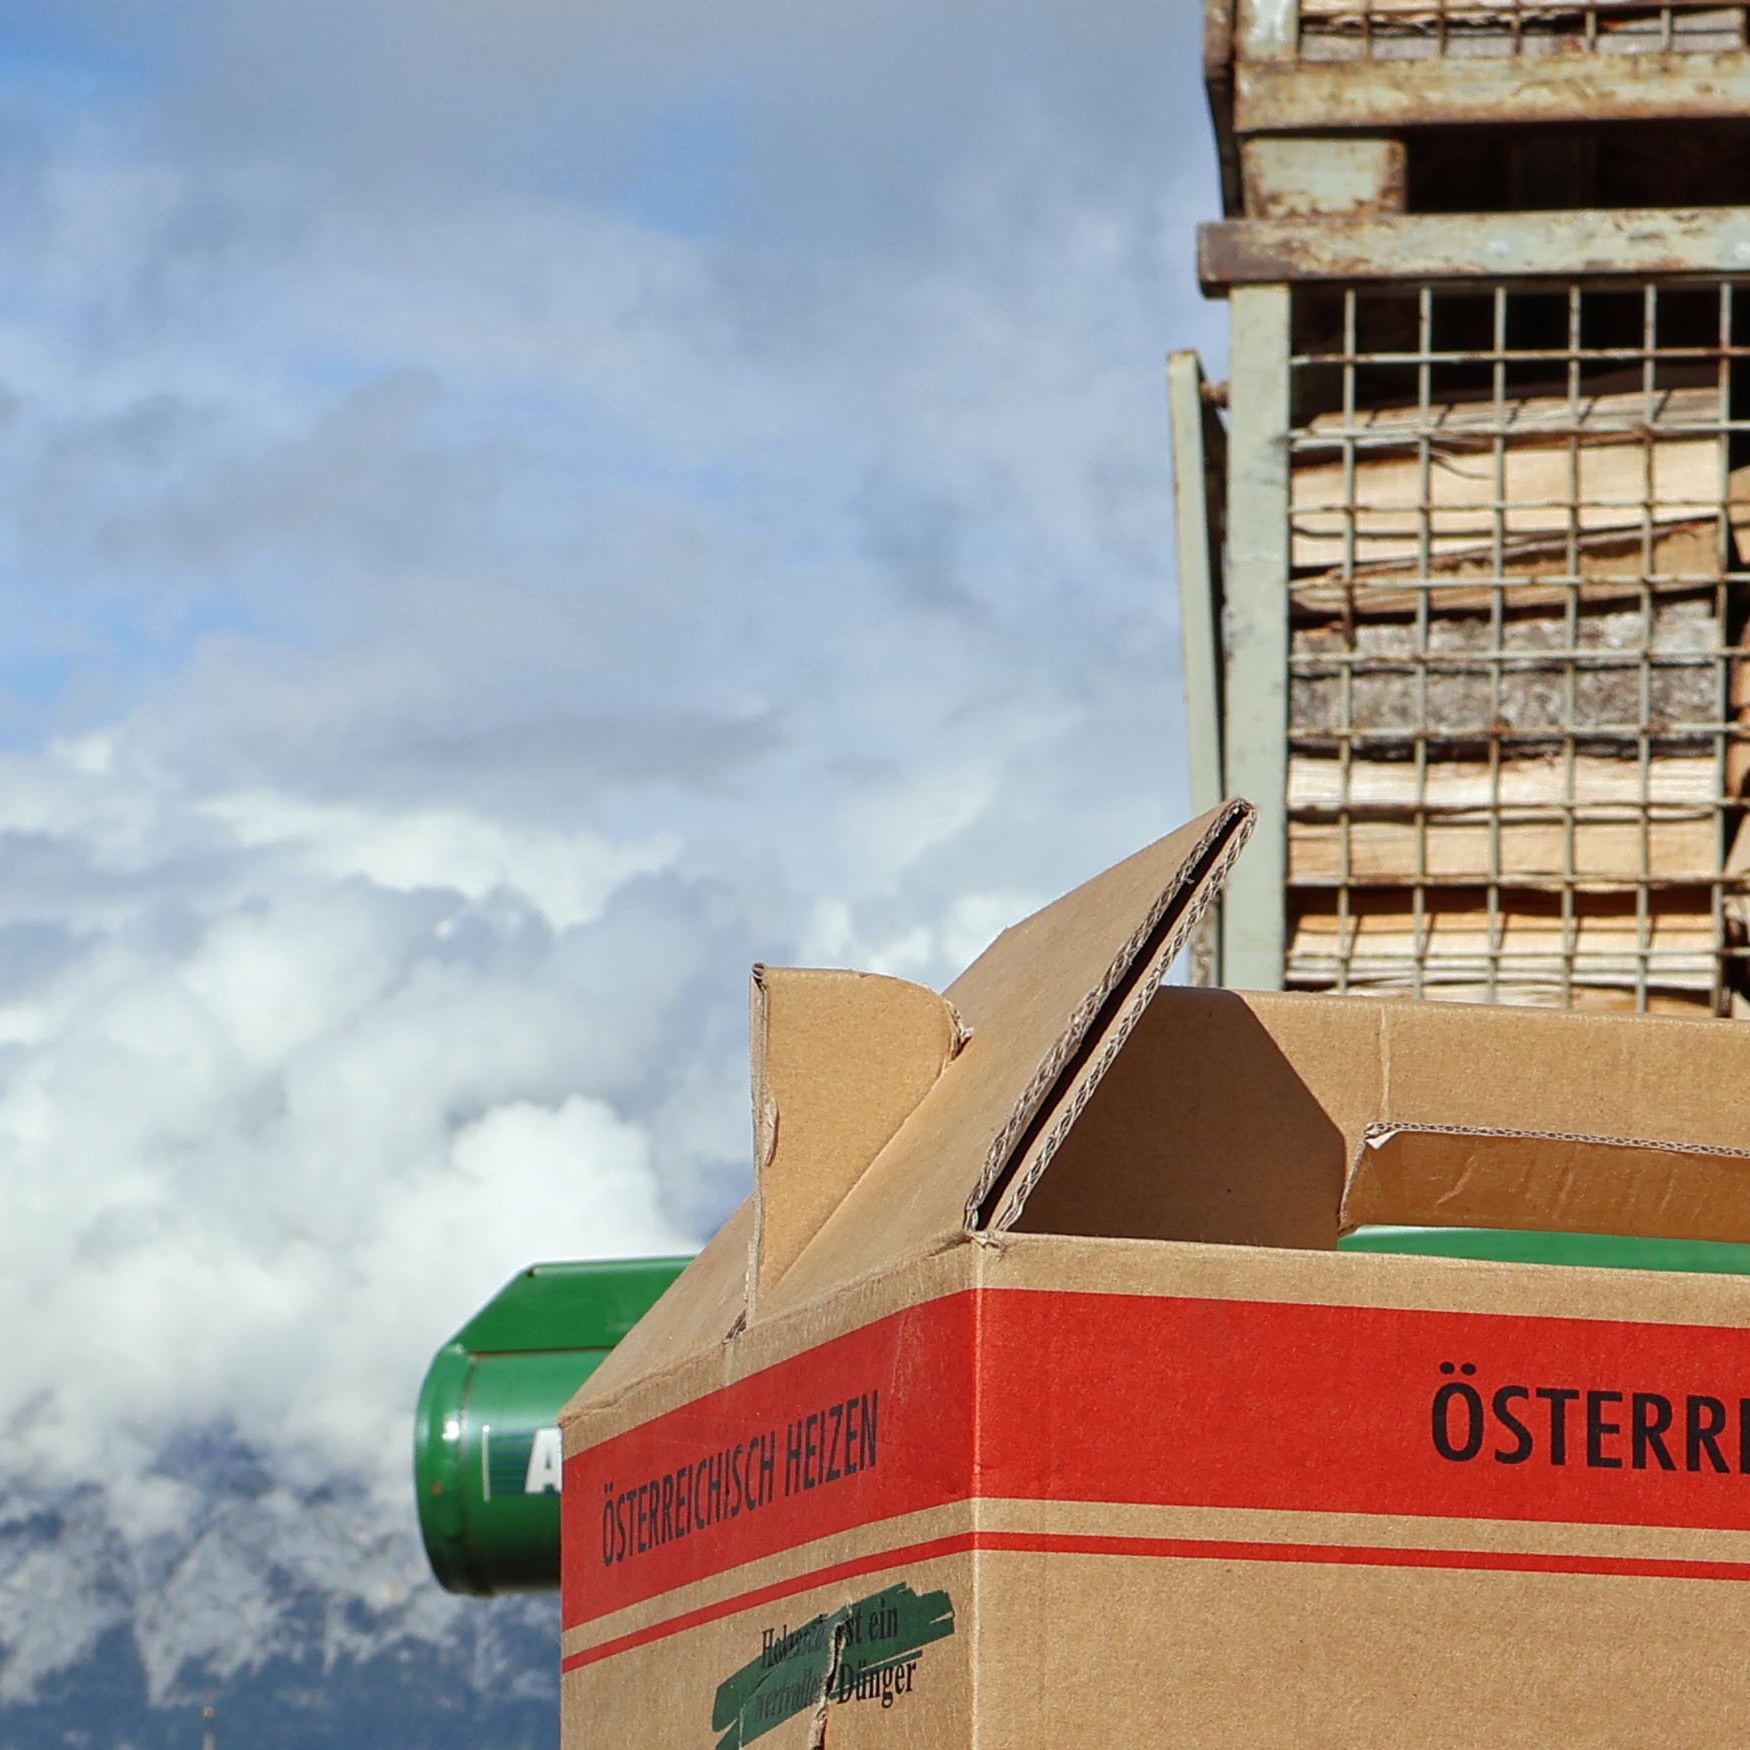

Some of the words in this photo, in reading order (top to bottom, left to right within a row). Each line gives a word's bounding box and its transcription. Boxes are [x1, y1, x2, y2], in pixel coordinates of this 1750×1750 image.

[603, 1431, 776, 1567] ÖSTERREICHISCH
[784, 1390, 879, 1497] HEIZEN
[868, 1598, 899, 1640] ein
[836, 1659, 918, 1709] Dünger
